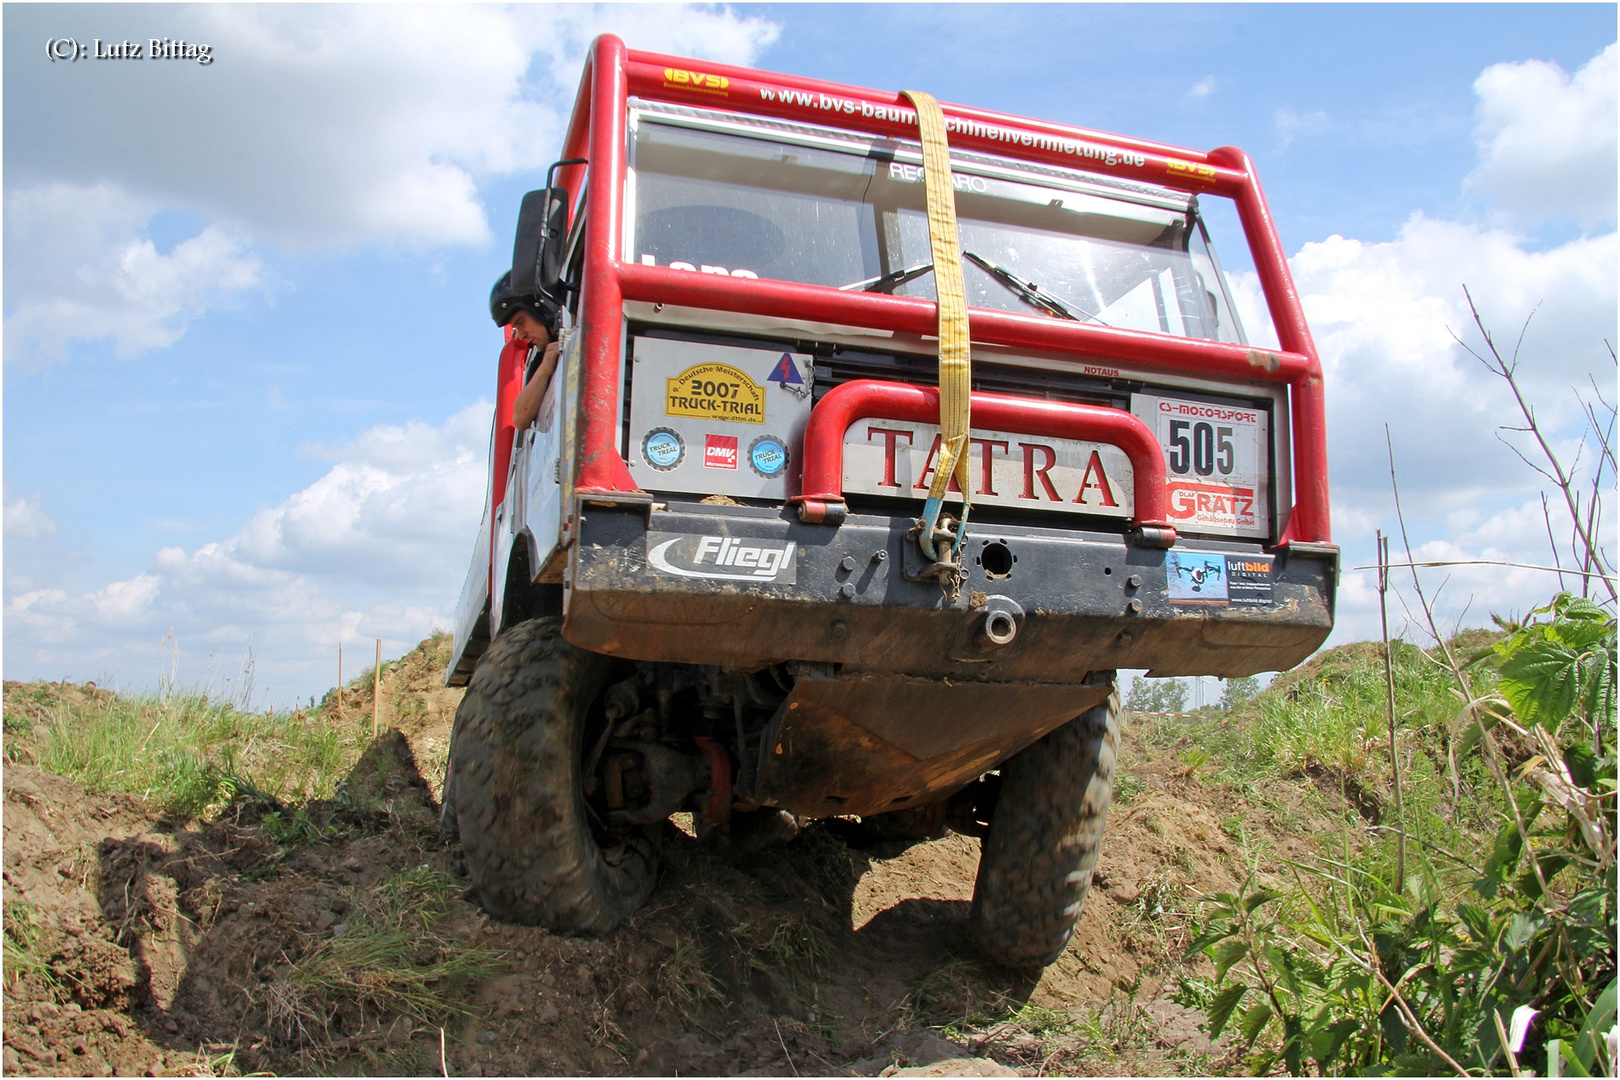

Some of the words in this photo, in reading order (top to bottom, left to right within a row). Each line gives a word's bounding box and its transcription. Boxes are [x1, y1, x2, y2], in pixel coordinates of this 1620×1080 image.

[672, 68, 722, 87] BVS
[759, 87, 1146, 167] www.bvs-baumchinenvermietung.de
[1084, 366, 1119, 377] NOTAUS
[679, 366, 713, 386] Deutsche
[715, 366, 760, 401] Meisterschaft
[691, 380, 740, 399] 2007
[669, 395, 761, 415] TRUCK-TRIAL
[1159, 402, 1257, 423] CS-MOTORSPORT
[711, 414, 757, 423] www.dttm.de
[649, 442, 671, 452] TRUCK
[658, 447, 677, 456] TRIAL
[706, 446, 736, 458] DMV
[755, 449, 776, 460] TRUCK
[1169, 420, 1234, 476] 505
[763, 454, 782, 464] TRIAL
[867, 427, 1120, 507] TATRA
[693, 536, 796, 576] Fliegl
[1227, 560, 1271, 573] luftbild
